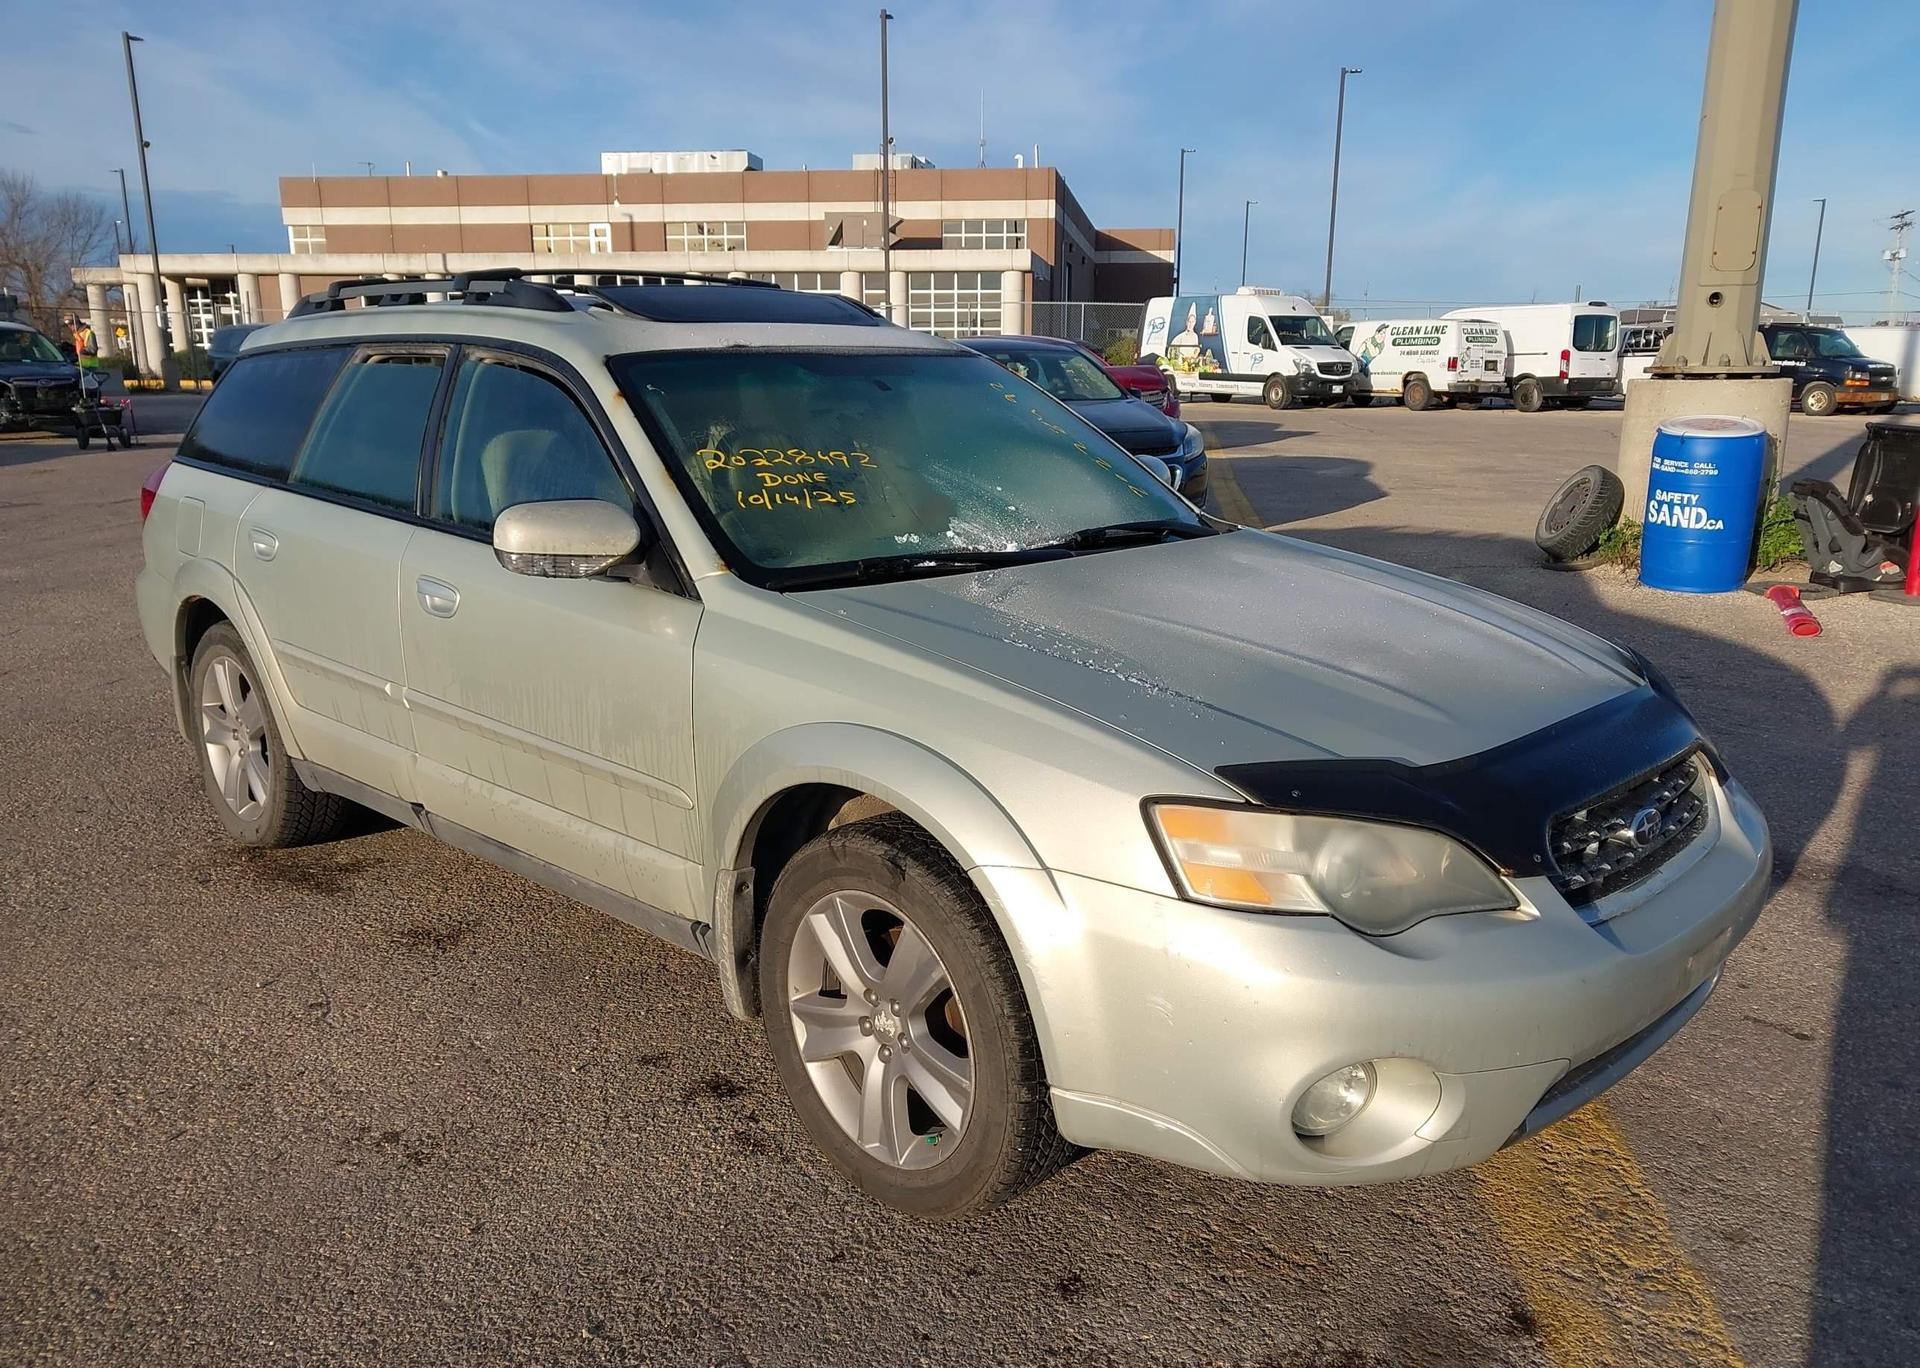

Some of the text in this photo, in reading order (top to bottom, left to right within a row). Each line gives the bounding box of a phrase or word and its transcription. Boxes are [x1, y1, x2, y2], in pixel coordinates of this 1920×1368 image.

[1391, 325, 1449, 335] CLEAN LINE
[1485, 328, 1499, 336] LINE
[697, 449, 878, 470] 20228492
[1664, 459, 1689, 467] SERVICE
[756, 472, 829, 487] DONE
[736, 488, 857, 511] 10/14/25
[1656, 489, 1699, 504] SAFETY
[1648, 499, 1724, 530] SAND.CA
